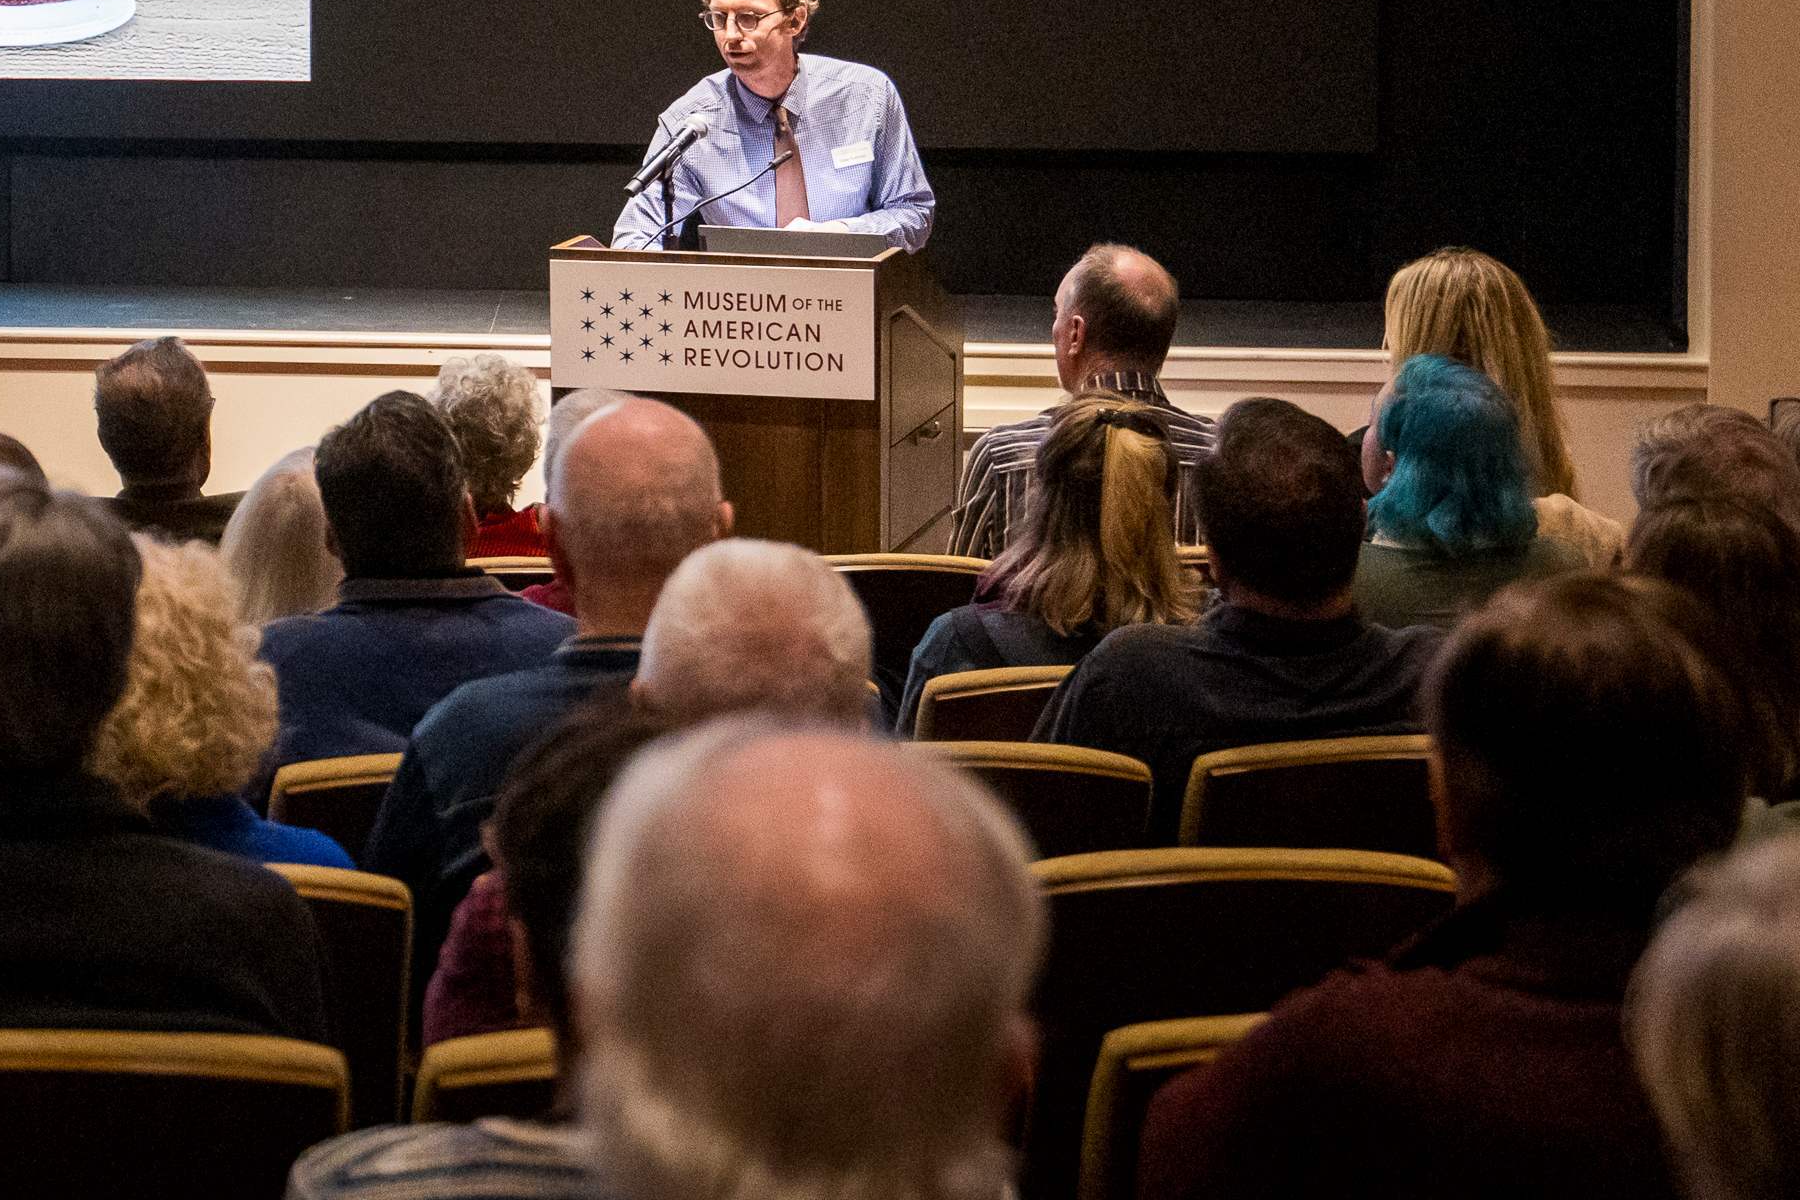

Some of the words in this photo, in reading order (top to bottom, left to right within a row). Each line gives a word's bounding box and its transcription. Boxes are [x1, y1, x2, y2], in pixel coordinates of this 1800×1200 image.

[685, 291, 786, 312] MUSEUM
[793, 298, 812, 310] OF
[818, 299, 842, 311] THE
[684, 320, 820, 342] AMERICAN
[685, 348, 843, 372] REVOLUTION
